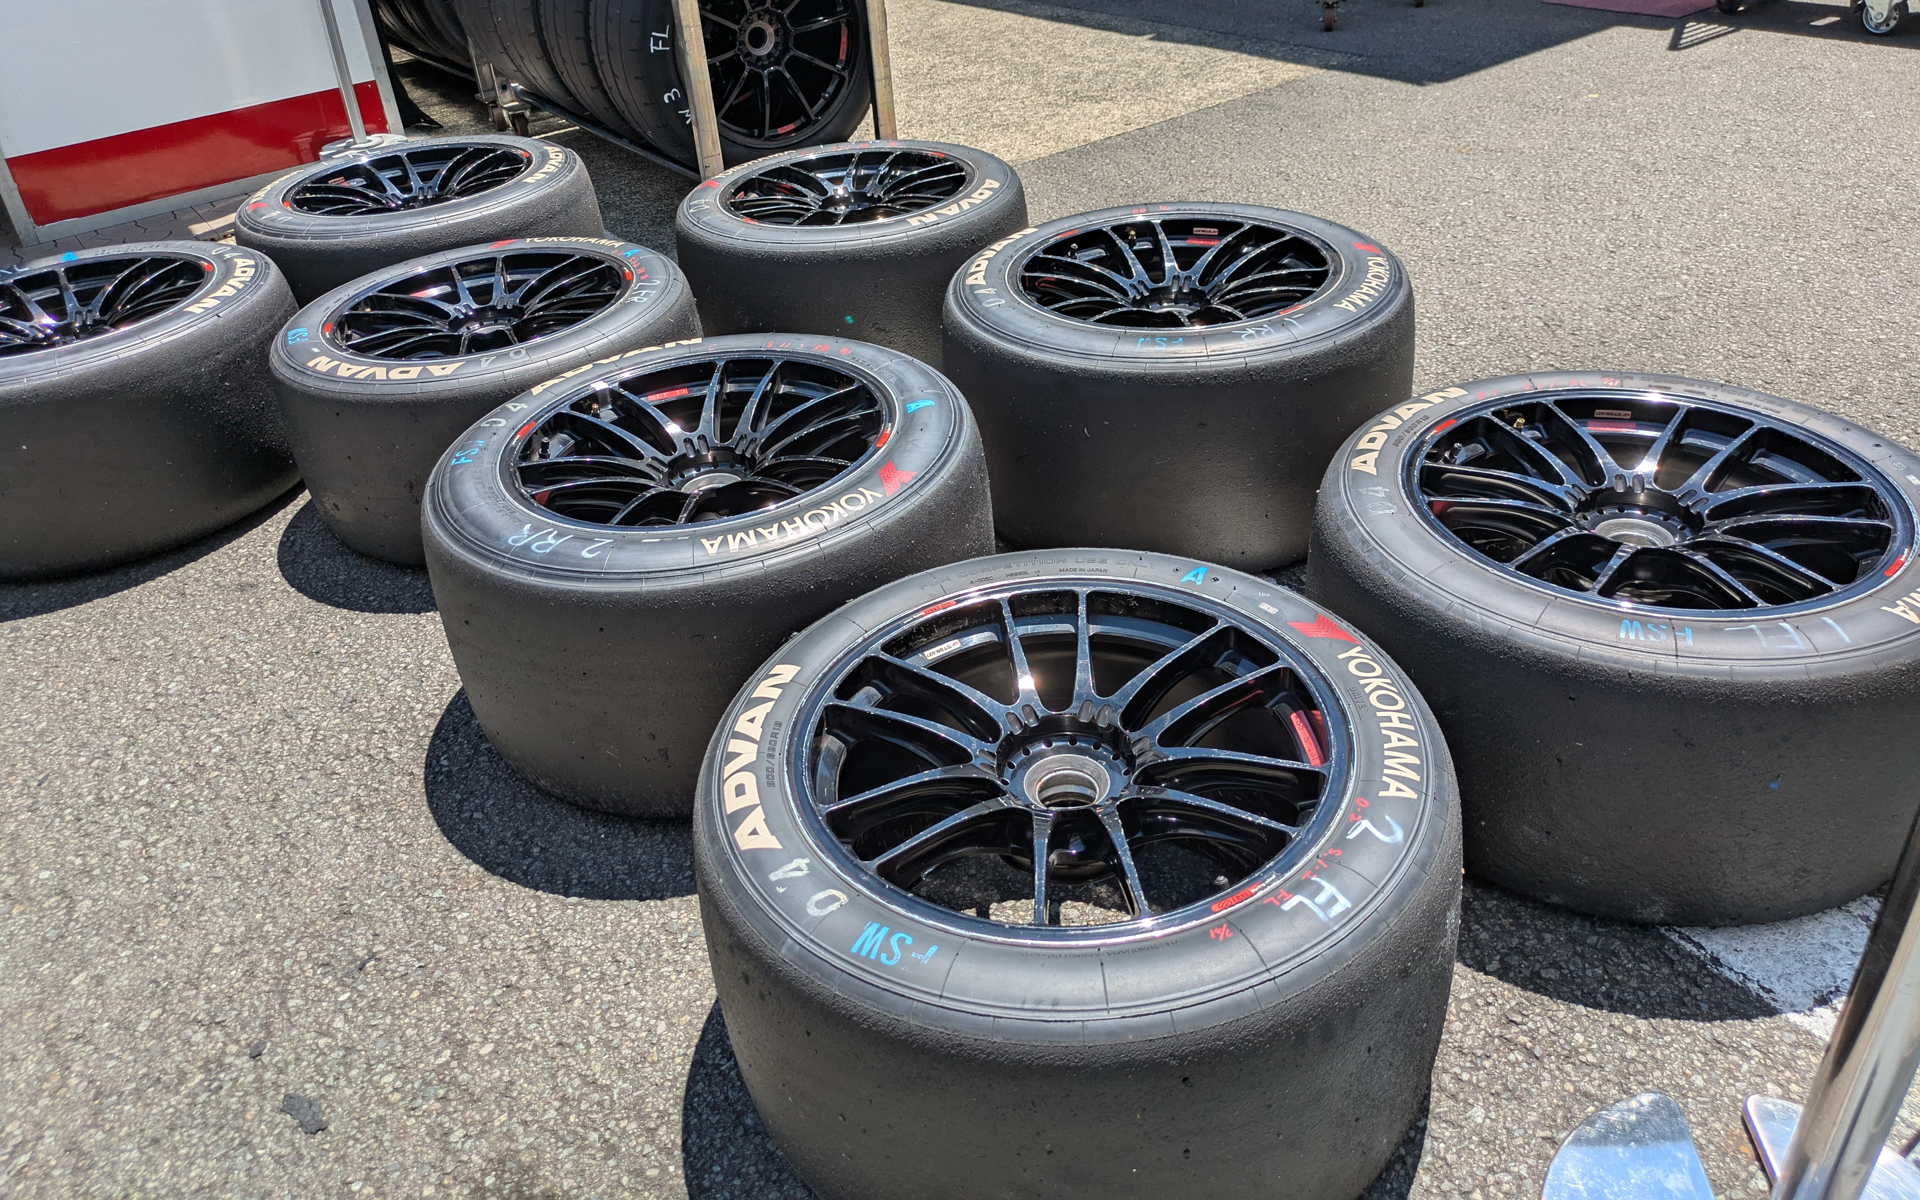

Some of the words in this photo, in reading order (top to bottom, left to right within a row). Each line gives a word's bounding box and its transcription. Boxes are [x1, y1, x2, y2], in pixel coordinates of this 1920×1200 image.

[650, 25, 670, 53] FL
[521, 146, 565, 183] ADVAN
[906, 178, 1001, 226] ADVAN
[965, 227, 1039, 285] ADVAN
[183, 258, 255, 314] ADVAN
[1333, 256, 1390, 312] YOKOHAMA
[306, 355, 466, 380] ADVAN
[531, 337, 703, 396] ADVAN
[1350, 386, 1469, 476] ADVAN
[700, 486, 883, 556] YOKOHAMA
[918, 575, 952, 591] FOR
[957, 557, 1067, 580] COMPETITION
[1075, 557, 1109, 565] USE
[1115, 558, 1158, 570] ONLY
[1180, 566, 1208, 586] A
[1348, 686, 1368, 711] DRIVE
[1337, 646, 1421, 800] YOKOHAMA
[723, 664, 802, 850] ADVAN
[1263, 889, 1293, 906] FL
[1280, 876, 1352, 923] FL
